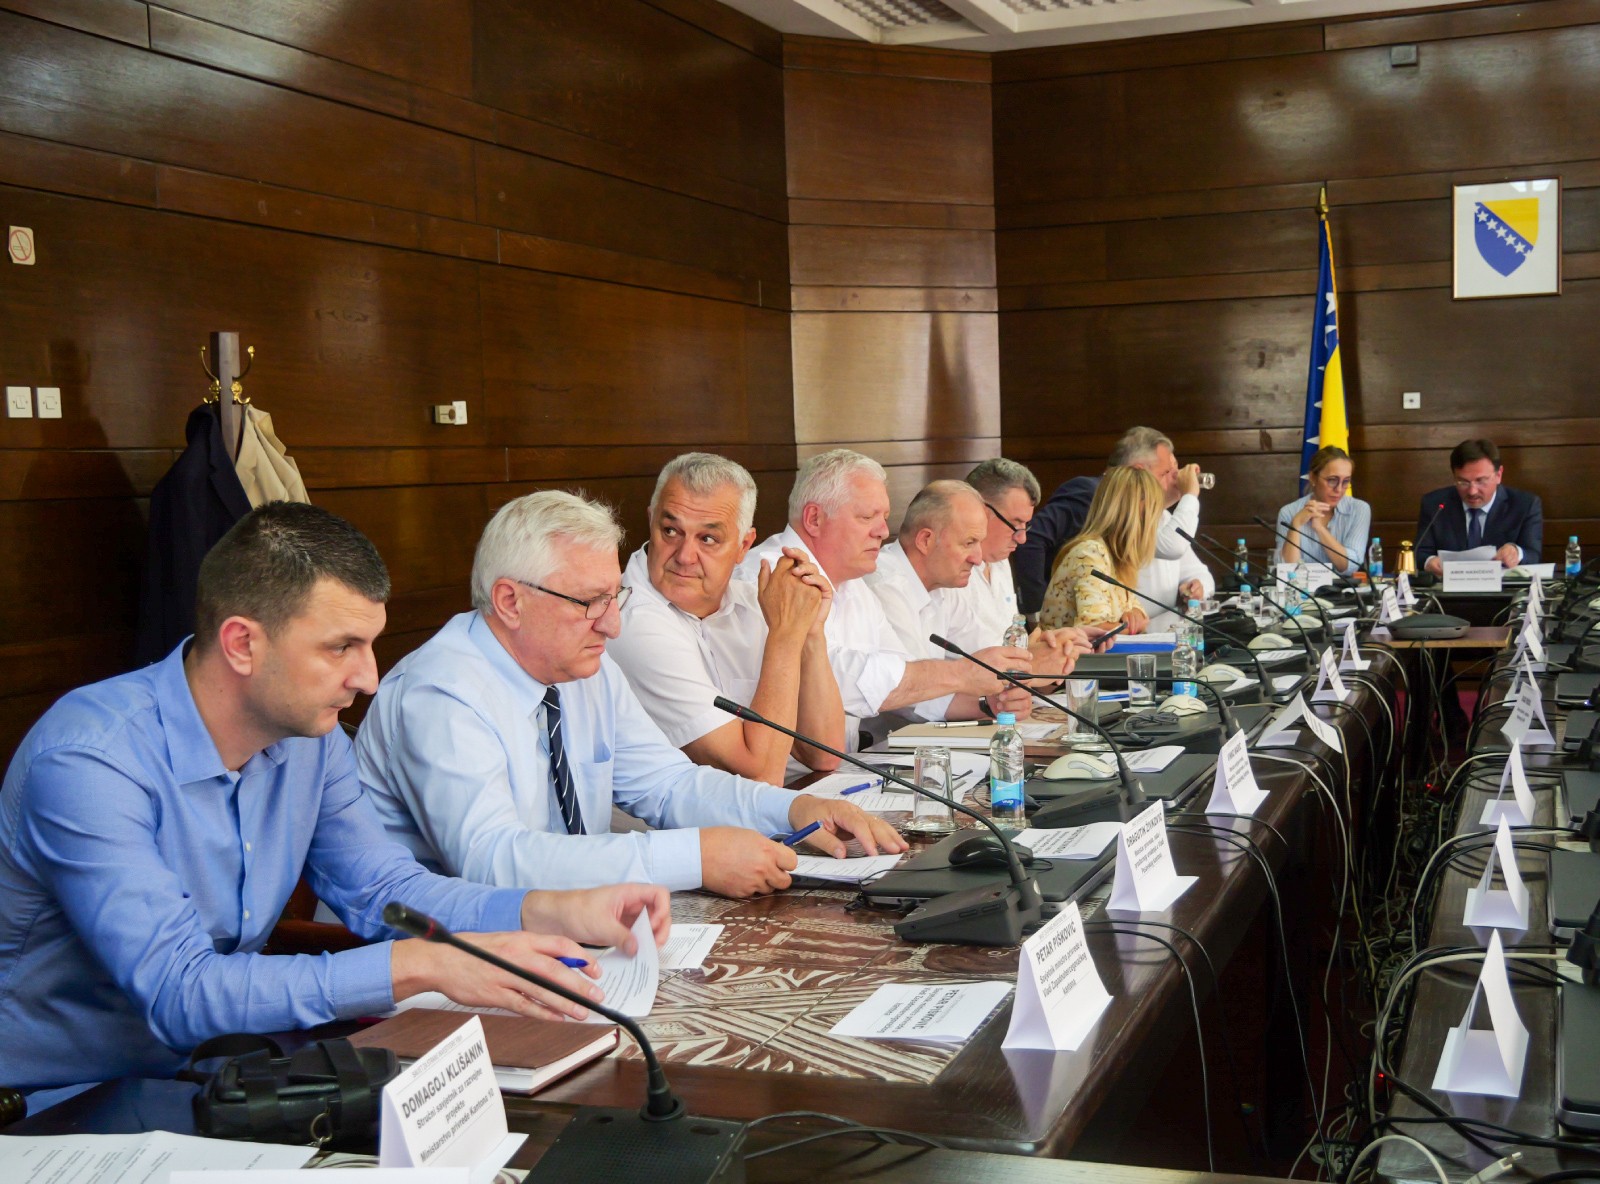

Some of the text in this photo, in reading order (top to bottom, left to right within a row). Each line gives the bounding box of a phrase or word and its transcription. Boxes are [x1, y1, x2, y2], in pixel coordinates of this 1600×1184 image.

[1035, 942, 1054, 965] PETAR
[1053, 920, 1077, 950] PIŠKOVIĆ
[402, 1040, 484, 1118] DOMAGOJ KLIŠANIN
[417, 1067, 482, 1129] Stručni savjetnik za razvojne
[420, 1131, 451, 1163] Ministarstvo
[451, 1112, 471, 1139] privrede
[470, 1095, 489, 1116] Kantona
[445, 1099, 465, 1124] projekte
